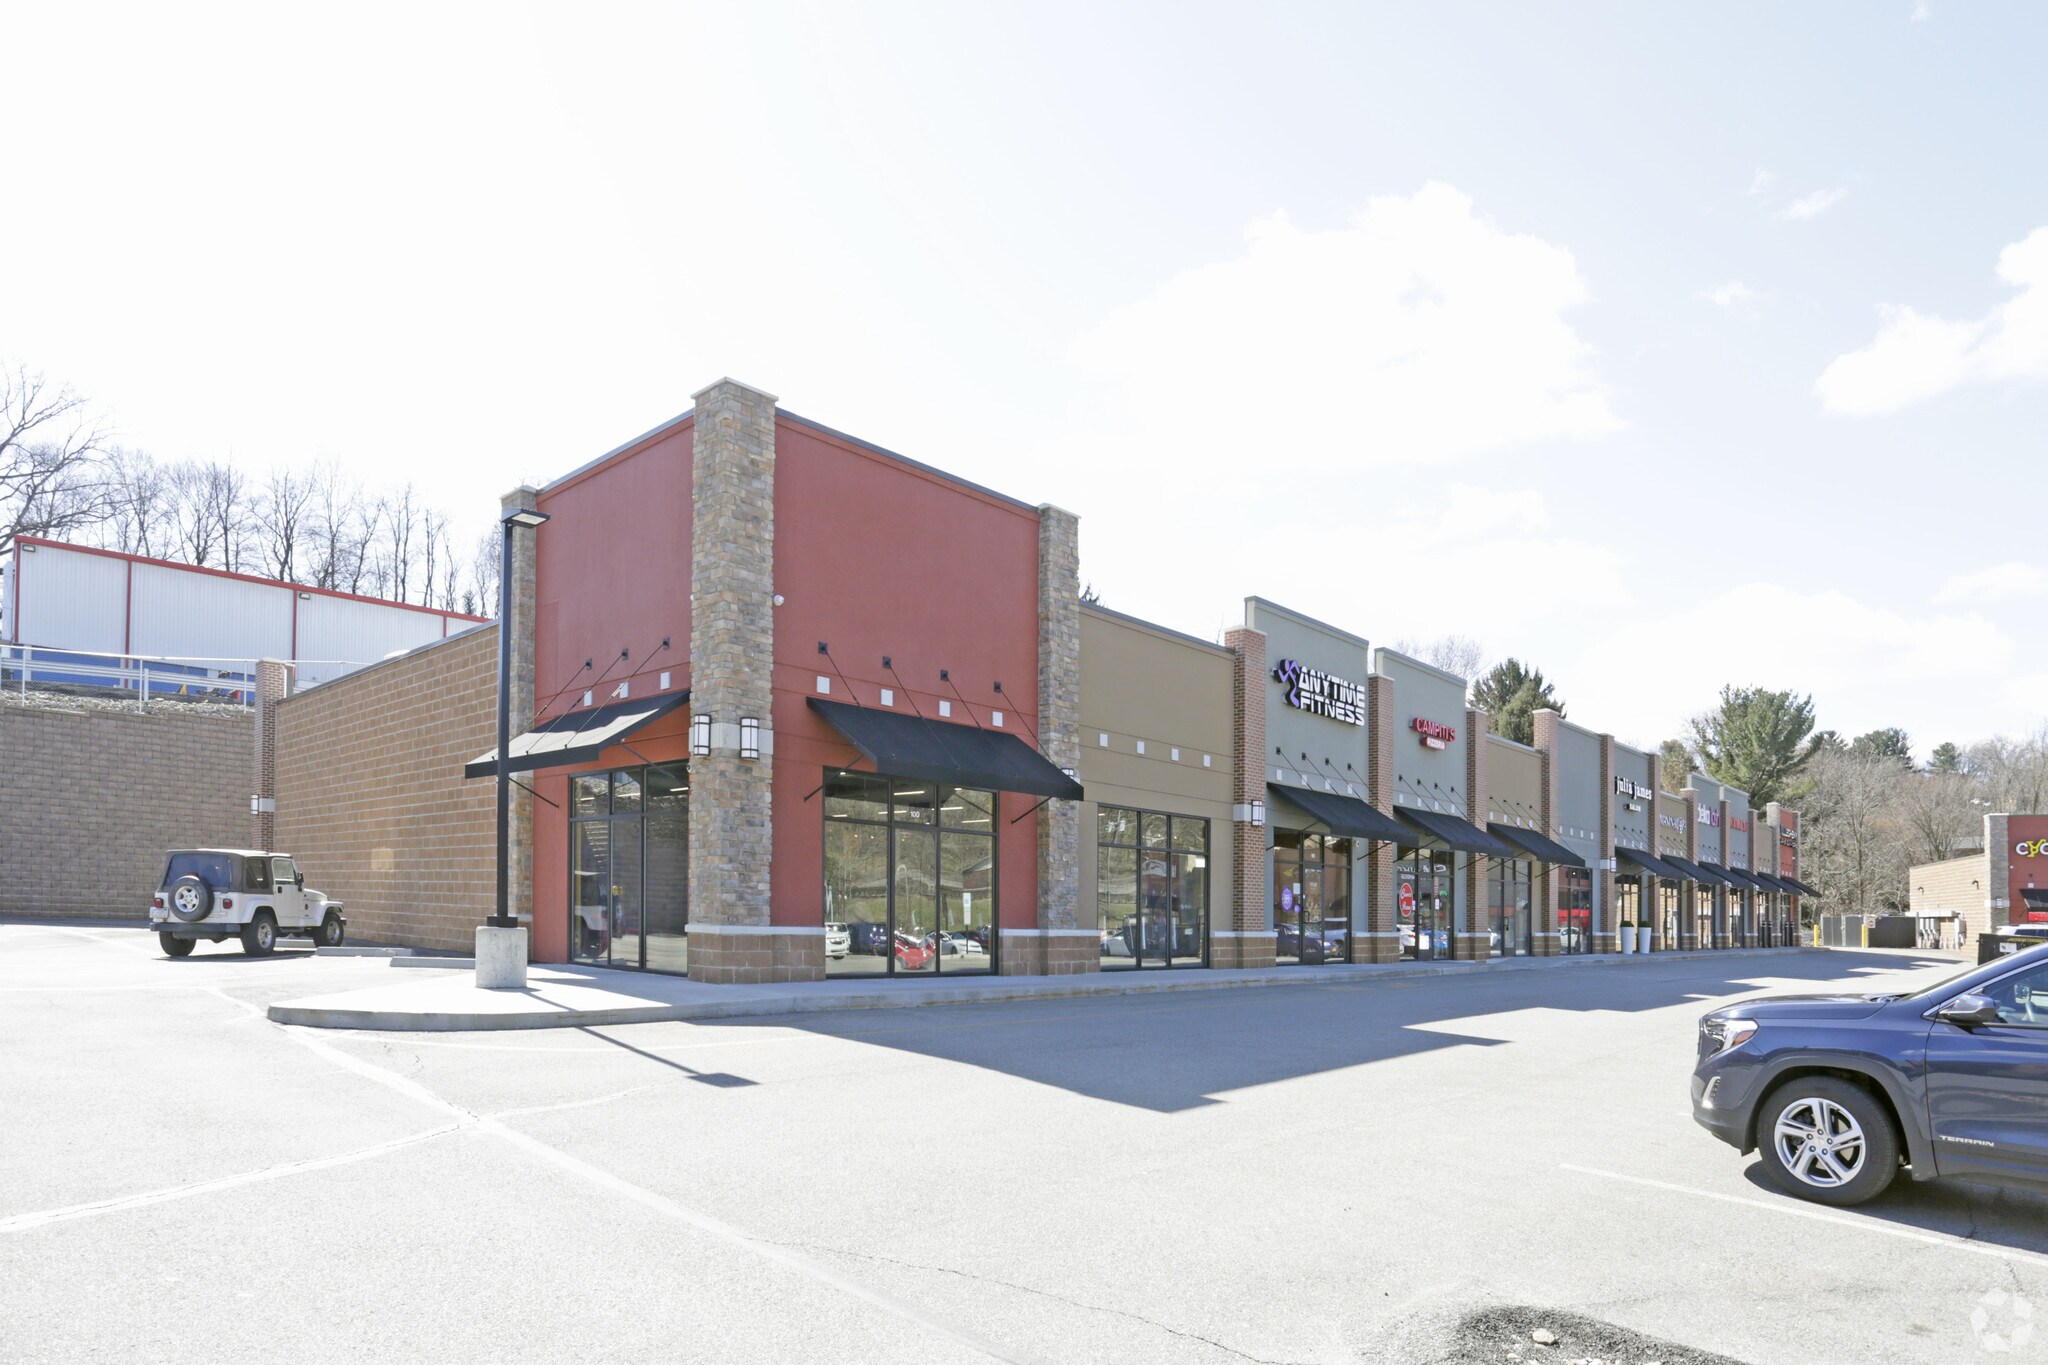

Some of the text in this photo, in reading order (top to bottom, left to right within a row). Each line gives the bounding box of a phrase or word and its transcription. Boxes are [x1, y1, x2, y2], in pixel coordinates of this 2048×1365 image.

[1298, 666, 1365, 708] ANYTIME
[1300, 690, 1365, 726] FITNESS
[1939, 1134, 1995, 1147] TERRAIN
